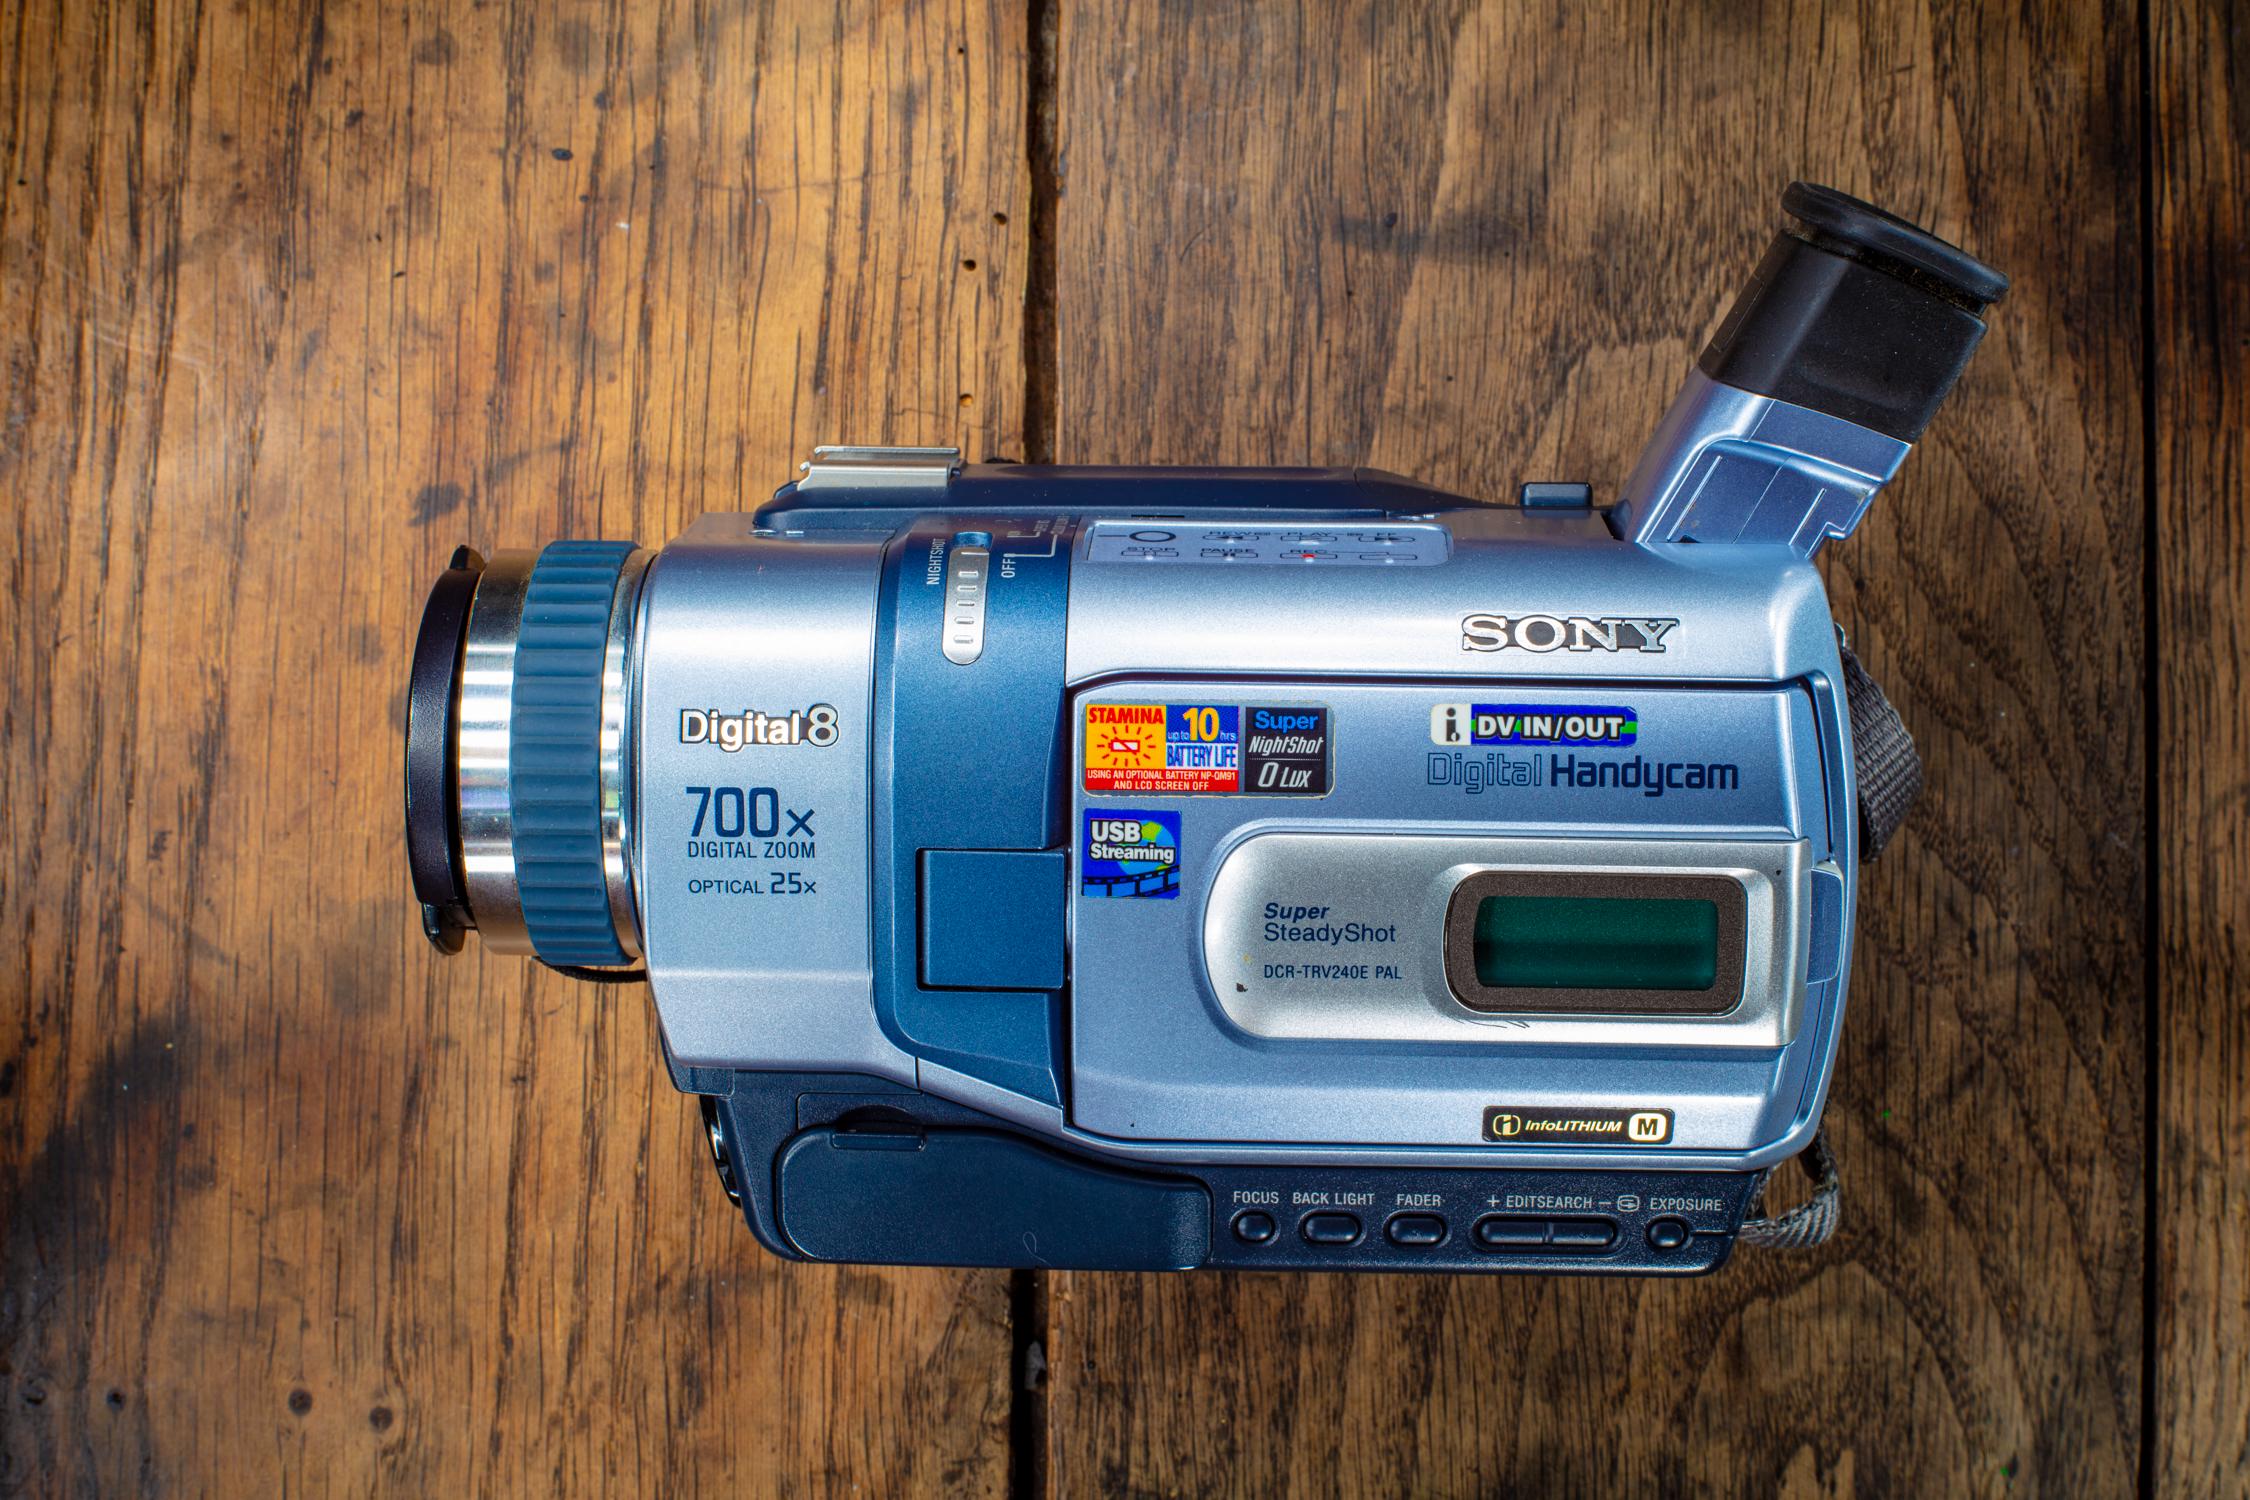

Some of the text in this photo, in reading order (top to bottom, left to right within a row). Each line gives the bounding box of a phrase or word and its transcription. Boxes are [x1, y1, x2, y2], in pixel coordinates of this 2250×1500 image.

[926, 538, 946, 585] NIGHTSHOT
[1001, 558, 1016, 578] OFF
[1462, 614, 1680, 653] SONY
[1088, 707, 1164, 724] STAMINA
[1168, 707, 1237, 742] up to 10 hrs
[1255, 710, 1319, 733] Super
[1477, 716, 1517, 739] DV
[1523, 716, 1624, 741] IN/OUT
[1166, 745, 1237, 767] BATTERY LIFE
[1249, 736, 1324, 756] NightShot
[1087, 770, 1111, 779] USING
[1113, 770, 1124, 779] AN
[1126, 770, 1163, 780] OPTIONAL
[1165, 770, 1199, 780] BATTERY
[1427, 752, 1739, 797] Digital Handycam
[1114, 780, 1209, 790] AND LCD SCREEN OFF
[1090, 820, 1142, 844] USB
[687, 841, 816, 859] DIGITAL ZOOM
[1090, 843, 1176, 864] Streaming
[688, 879, 764, 894] OPTICAL
[1264, 902, 1330, 923] Super
[1264, 922, 1397, 946] SteadyShot
[1264, 964, 1402, 980] DCR-TRV240E PAL
[1525, 1118, 1659, 1136] InfoLITHIUM M
[1233, 1190, 1279, 1204] FOCUS
[1292, 1191, 1376, 1206] BACK LIGHT
[1396, 1193, 1441, 1207] FADER
[1506, 1195, 1593, 1209] EDITSEARCH
[1650, 1197, 1723, 1211] EXPOSURE
